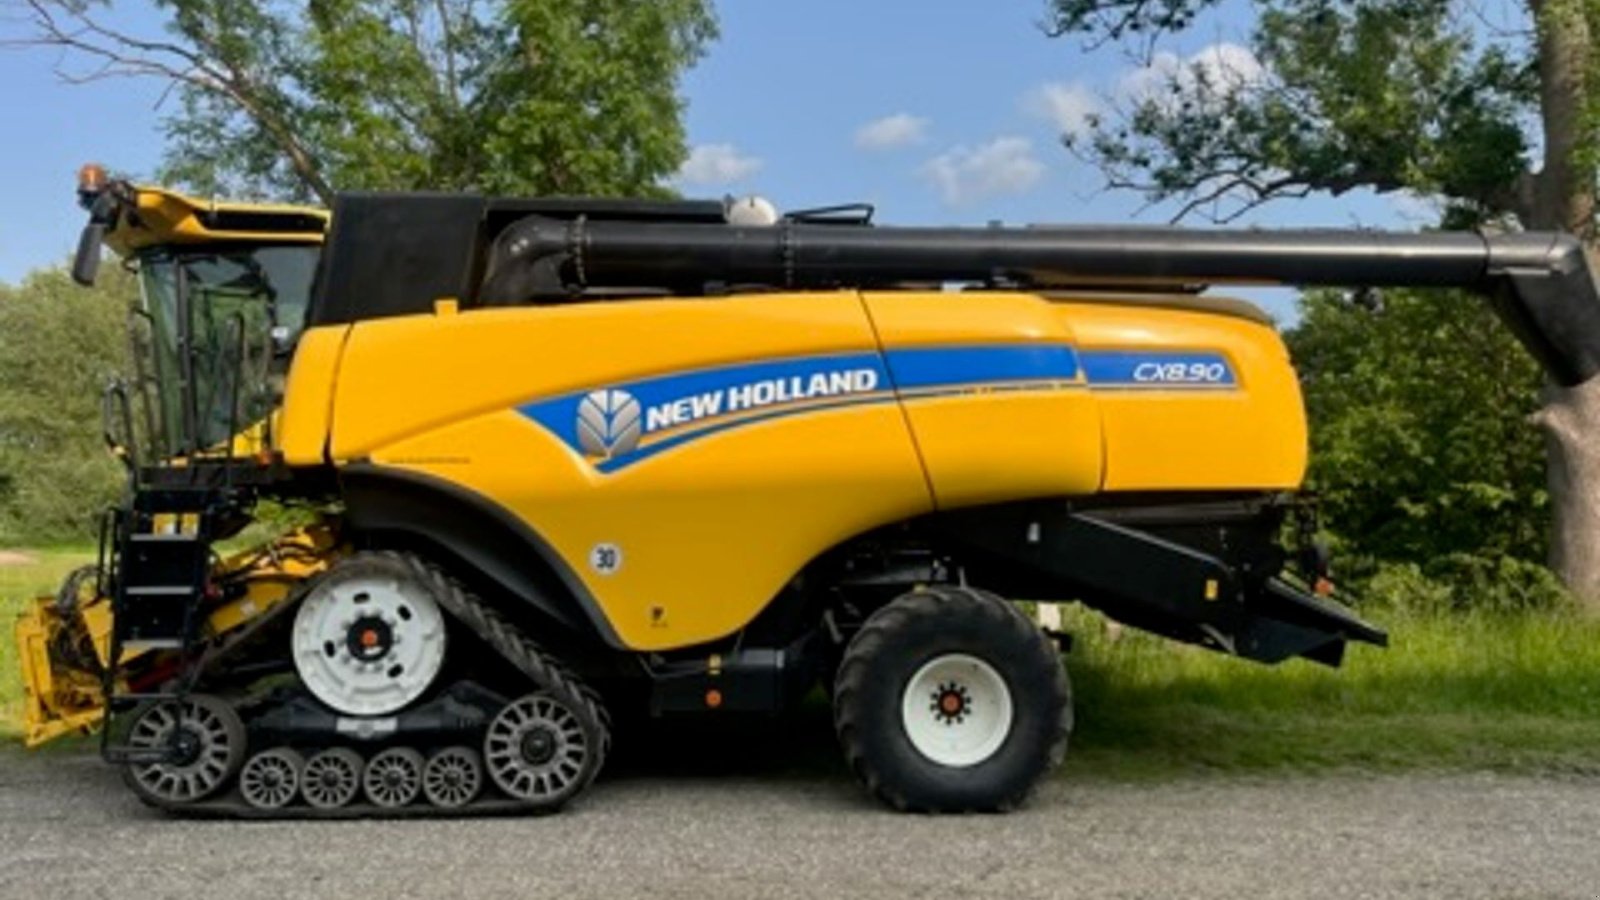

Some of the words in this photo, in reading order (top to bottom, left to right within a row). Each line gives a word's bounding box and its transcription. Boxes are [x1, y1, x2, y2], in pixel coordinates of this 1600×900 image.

[646, 390, 721, 431] NEW
[728, 369, 877, 410] HOLLAND
[596, 547, 616, 570] 30
